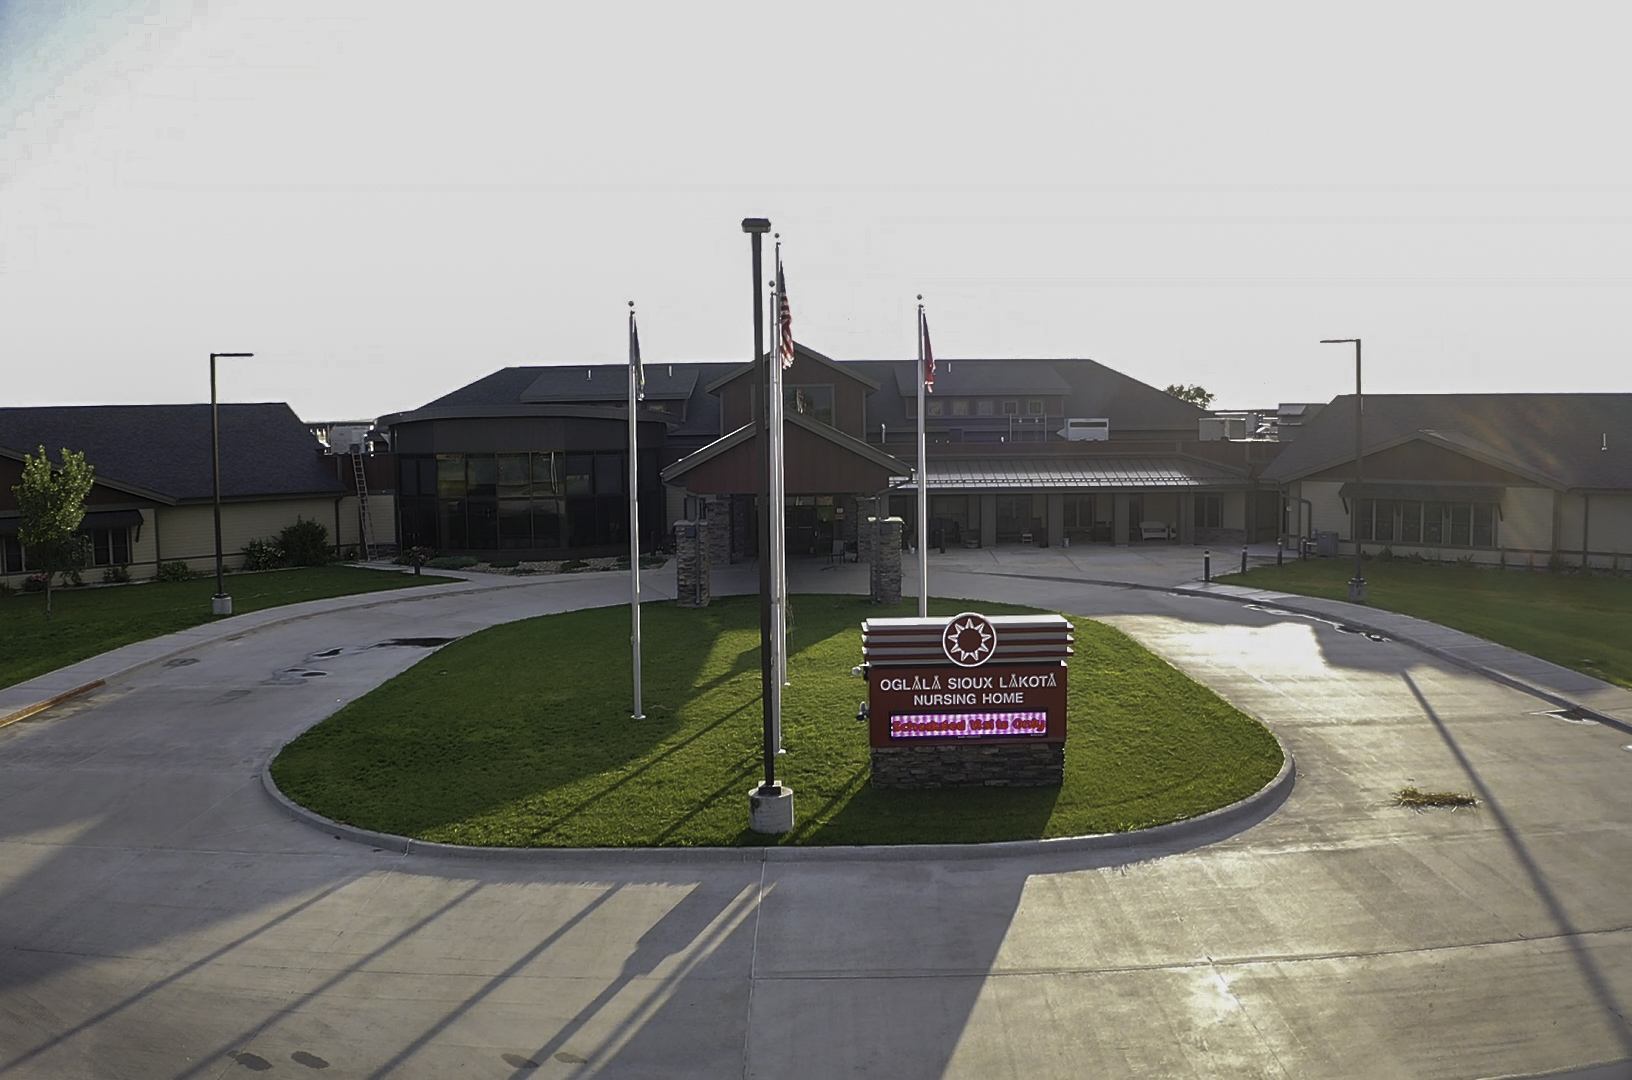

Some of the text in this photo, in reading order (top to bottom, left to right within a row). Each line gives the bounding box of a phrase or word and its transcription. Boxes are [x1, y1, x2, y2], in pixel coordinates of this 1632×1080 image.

[880, 673, 1057, 691] OGLALA SIOUX LAKOTA
[913, 692, 1024, 706] NURSING HOME
[1012, 717, 1045, 731] Only
